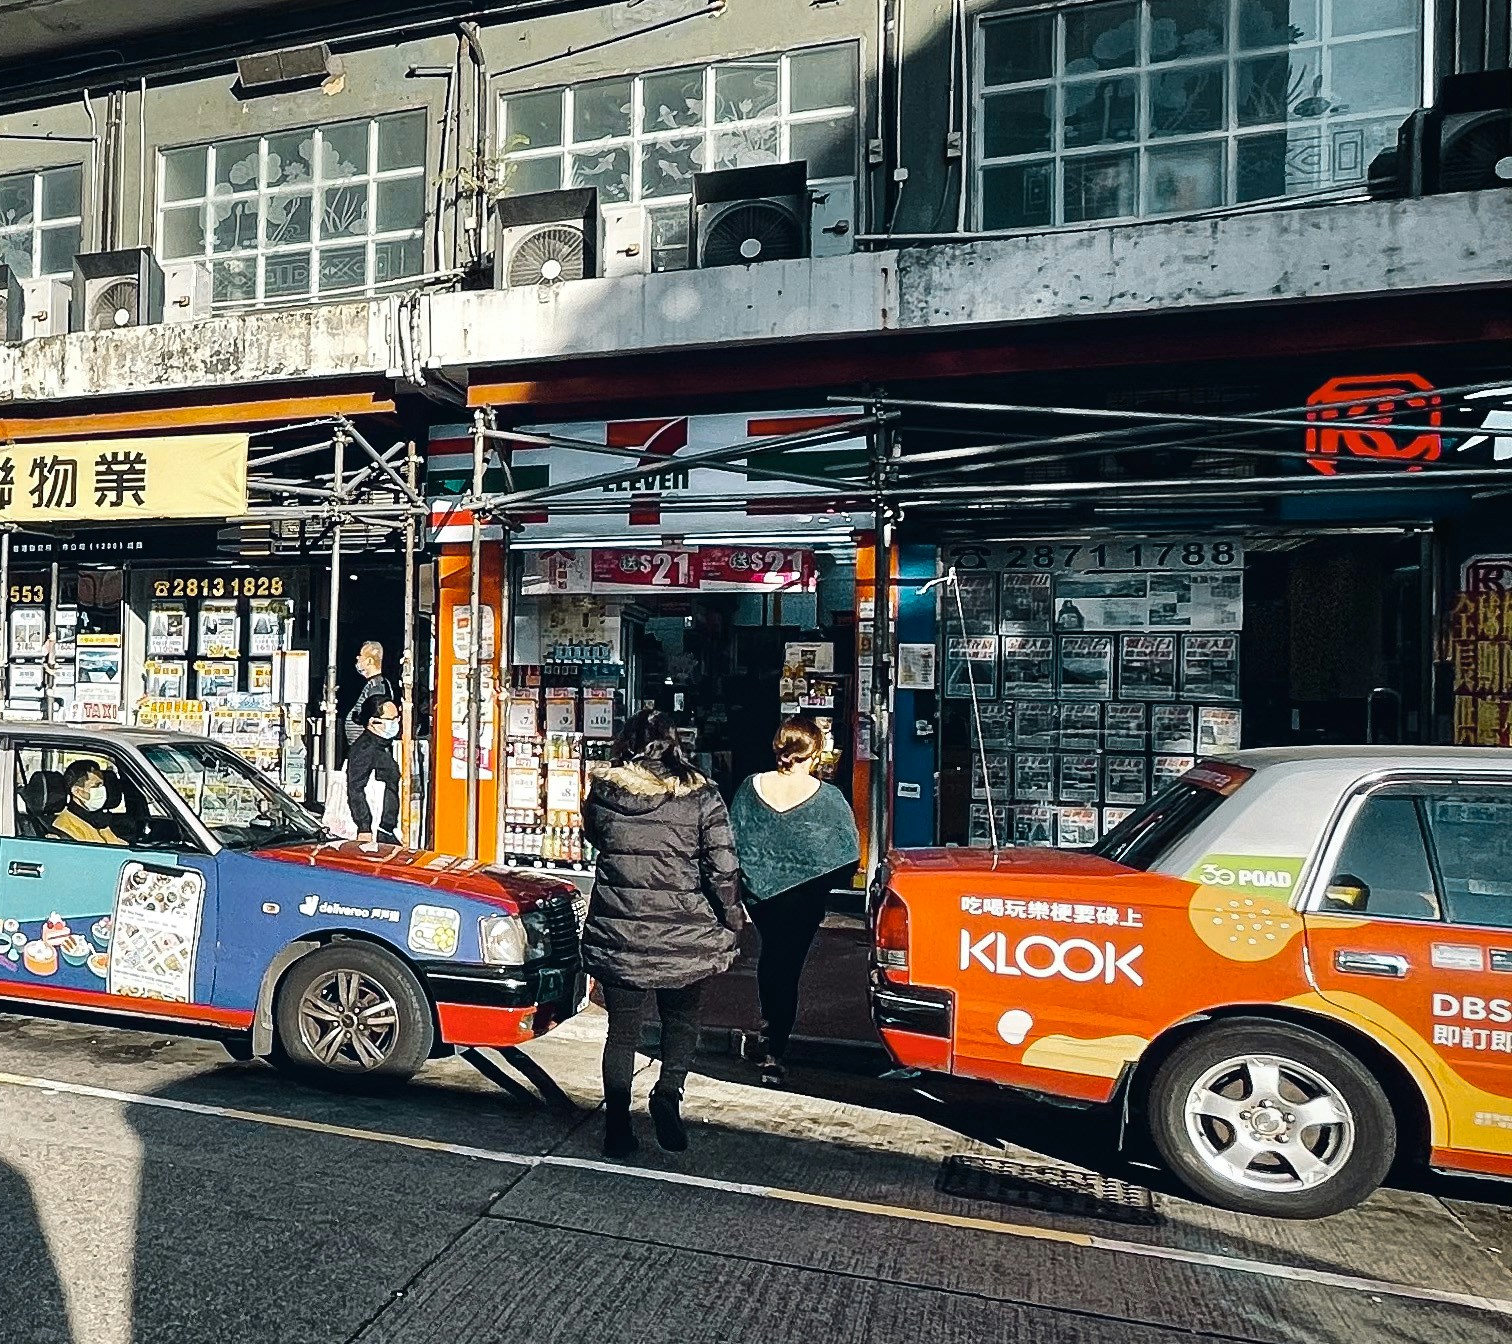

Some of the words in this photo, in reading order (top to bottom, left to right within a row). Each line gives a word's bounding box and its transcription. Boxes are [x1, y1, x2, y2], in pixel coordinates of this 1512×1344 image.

[1006, 544, 1109, 568] 2871
[1129, 541, 1237, 566] 1788
[0, 585, 44, 603] 553
[172, 577, 225, 597] 2813
[231, 576, 284, 596] 1828
[83, 702, 118, 720] TAXI
[959, 927, 1145, 988] KLOOK
[1432, 992, 1512, 1024] DBS
